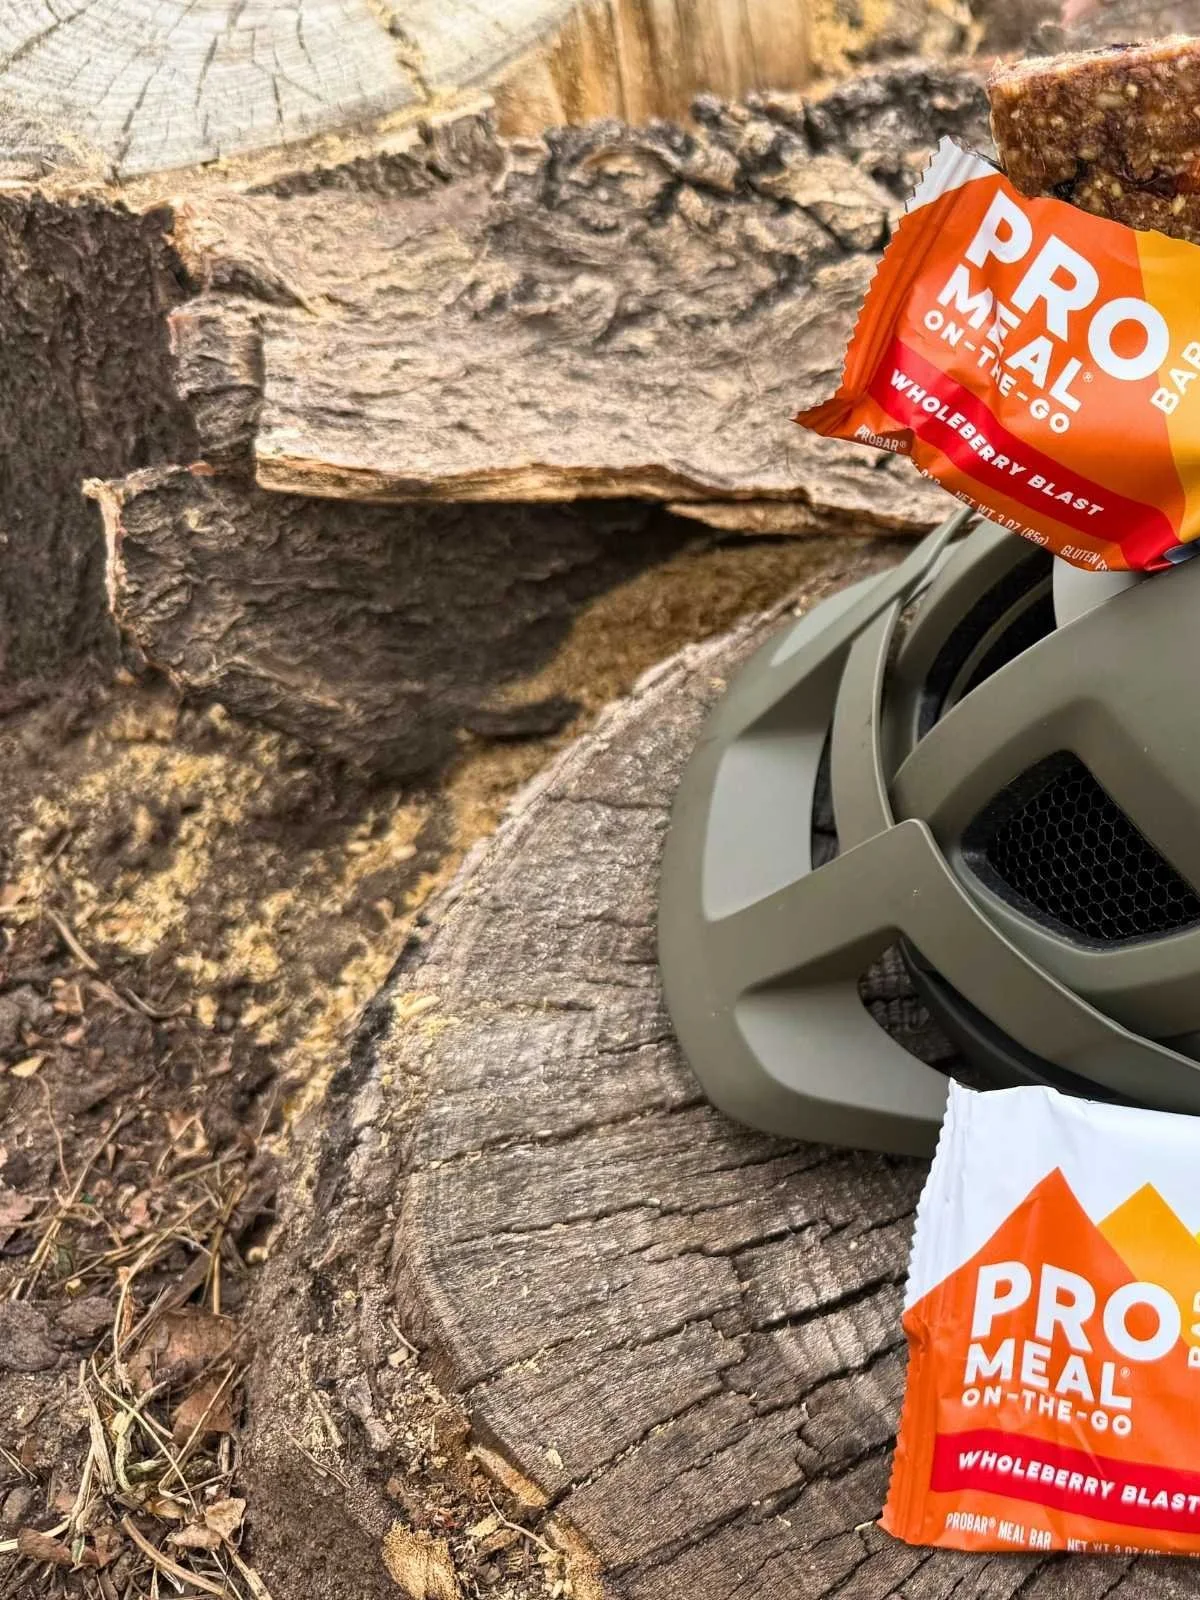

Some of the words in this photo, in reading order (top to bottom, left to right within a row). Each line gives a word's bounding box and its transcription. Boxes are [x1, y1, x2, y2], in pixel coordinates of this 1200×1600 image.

[965, 190, 1169, 380] PRO
[924, 310, 1070, 433] ON-THE-GO
[890, 368, 1027, 476] WHOLEBERRY
[1028, 475, 1104, 516] BLAST
[1060, 545, 1101, 566] GLUTEN
[971, 1260, 1181, 1361] PRO
[962, 1386, 1132, 1436] ON-THE-GO
[958, 1450, 1115, 1499] WHOLEBERRY
[998, 1520, 1025, 1543] MEAL
[1029, 1528, 1051, 1551] BAR
